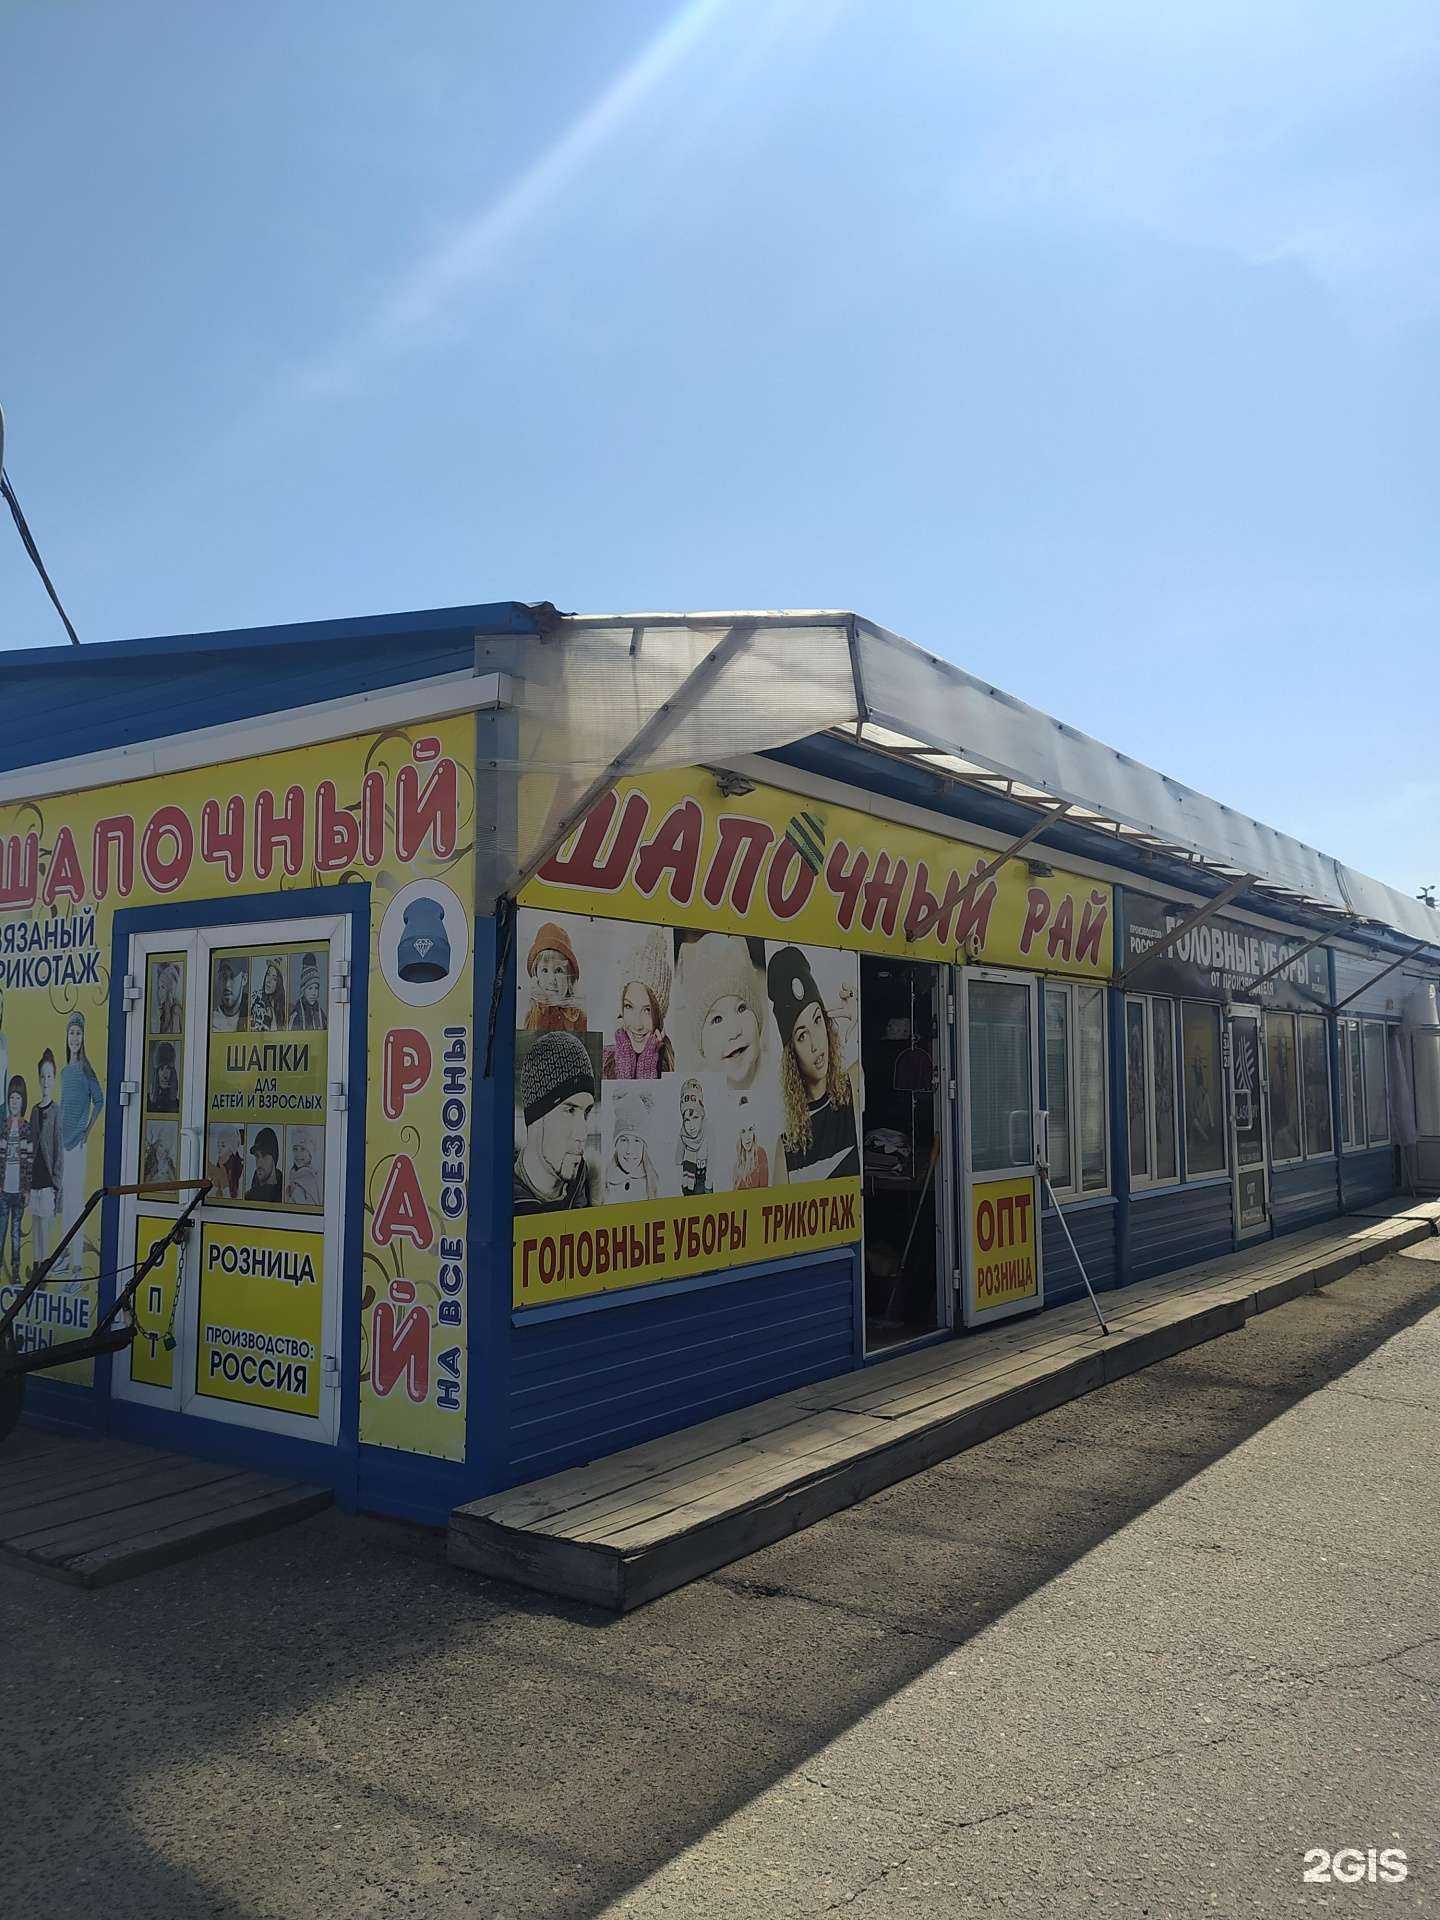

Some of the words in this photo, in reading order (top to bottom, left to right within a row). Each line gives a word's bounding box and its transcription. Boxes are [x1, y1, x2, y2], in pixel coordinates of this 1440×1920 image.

[0, 737, 458, 912] ШАПОЧНЫЙ
[532, 788, 997, 951] ШАПОЧНЫЙ
[1018, 888, 1108, 967] РАЙ
[0, 906, 95, 954] ЯЗАНЫЙ
[1130, 936, 1162, 958] РОСС
[1166, 915, 1260, 976] ГОЛОВНЫЕ
[1262, 941, 1309, 986] УБОРЫ
[1210, 971, 1221, 988] ОТ
[226, 1043, 310, 1072] ШАПКИ
[211, 1091, 244, 1110] ДЕТЕЙ
[247, 1094, 255, 1108] И
[258, 1094, 322, 1110] ВЗРОСЛЫХ
[254, 1077, 277, 1094] ДЛЯ
[440, 1026, 467, 1219] СЕЗОНЫ
[372, 1028, 433, 1402] РАЙ
[976, 1194, 1031, 1252] ОПТ
[522, 1220, 666, 1288] ГОЛОВНЫЕ
[673, 1209, 748, 1261] УБОРЫ
[761, 1193, 856, 1244] ТРИКОТАЖ
[208, 1244, 316, 1287] РОЗНИЦА
[439, 1238, 464, 1326] ВСЕ
[977, 1257, 1033, 1299] РОЗНИЦА
[206, 1326, 315, 1360] ПРОИЗВОДСТВО:
[210, 1350, 308, 1395] РОССИЯ
[437, 1346, 462, 1410] НА
